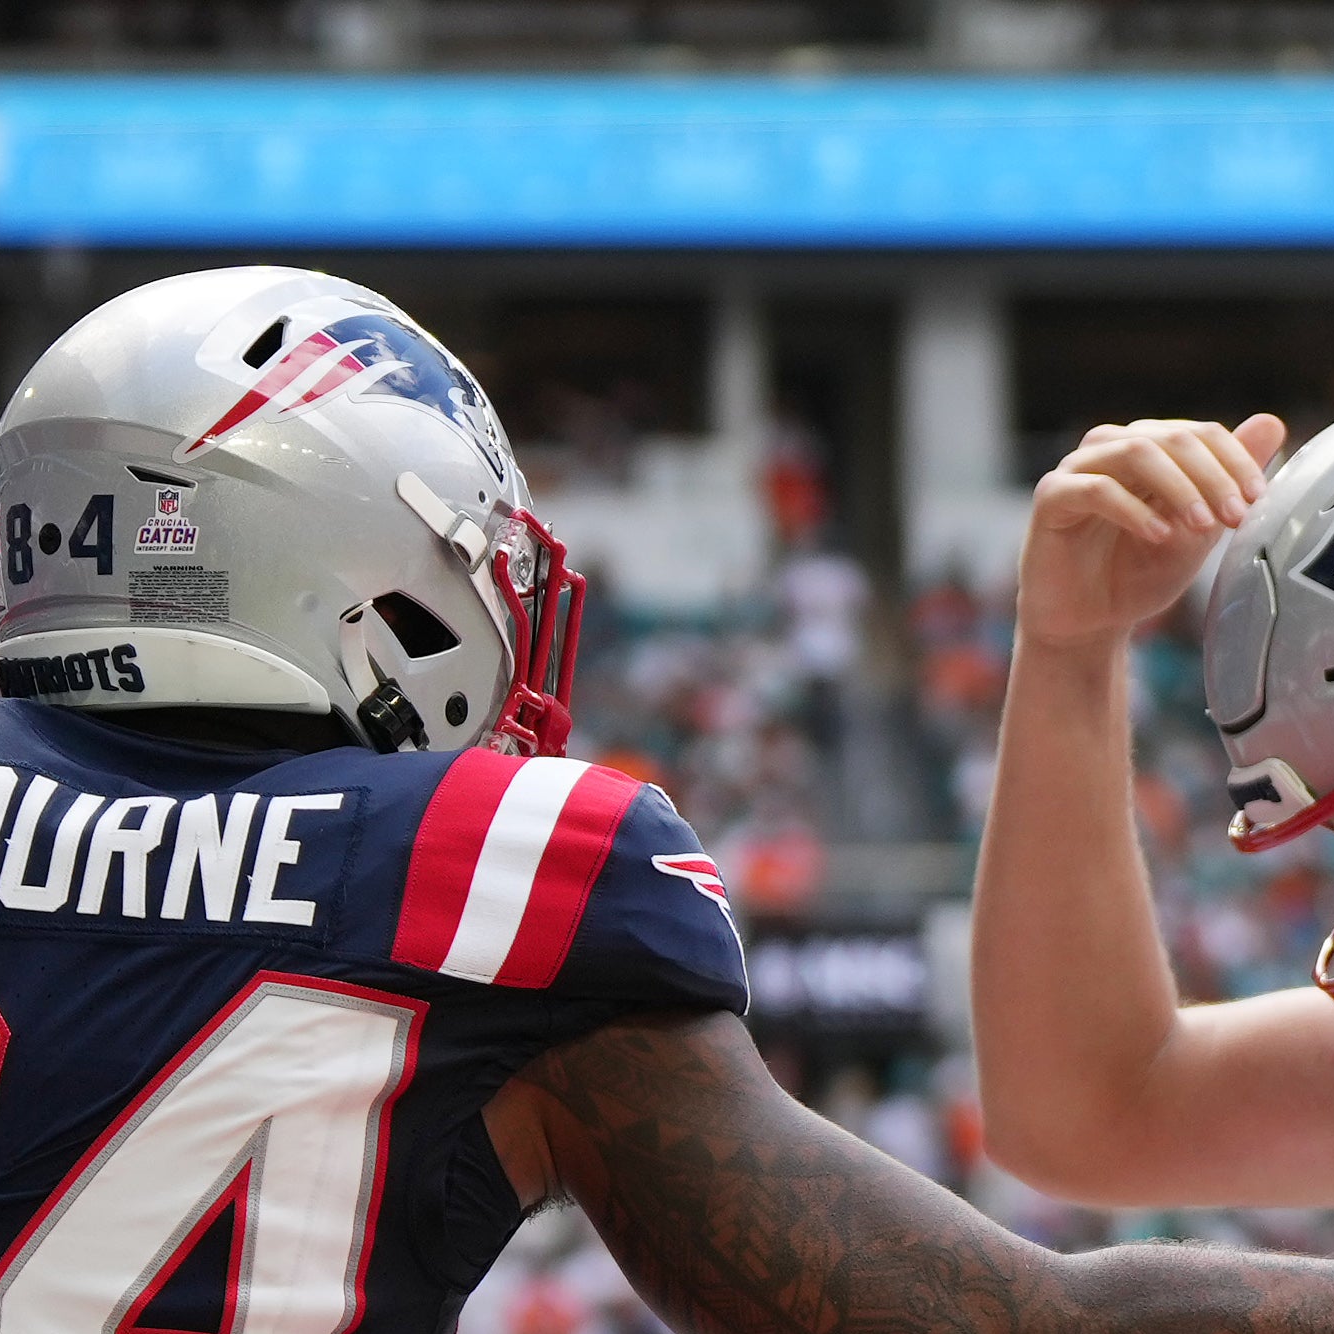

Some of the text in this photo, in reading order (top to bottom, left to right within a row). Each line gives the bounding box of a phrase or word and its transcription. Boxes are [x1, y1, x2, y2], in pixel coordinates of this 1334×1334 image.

[160, 499, 178, 512] NFL
[147, 518, 188, 527] CRUCIAL
[138, 527, 197, 544] CATCH
